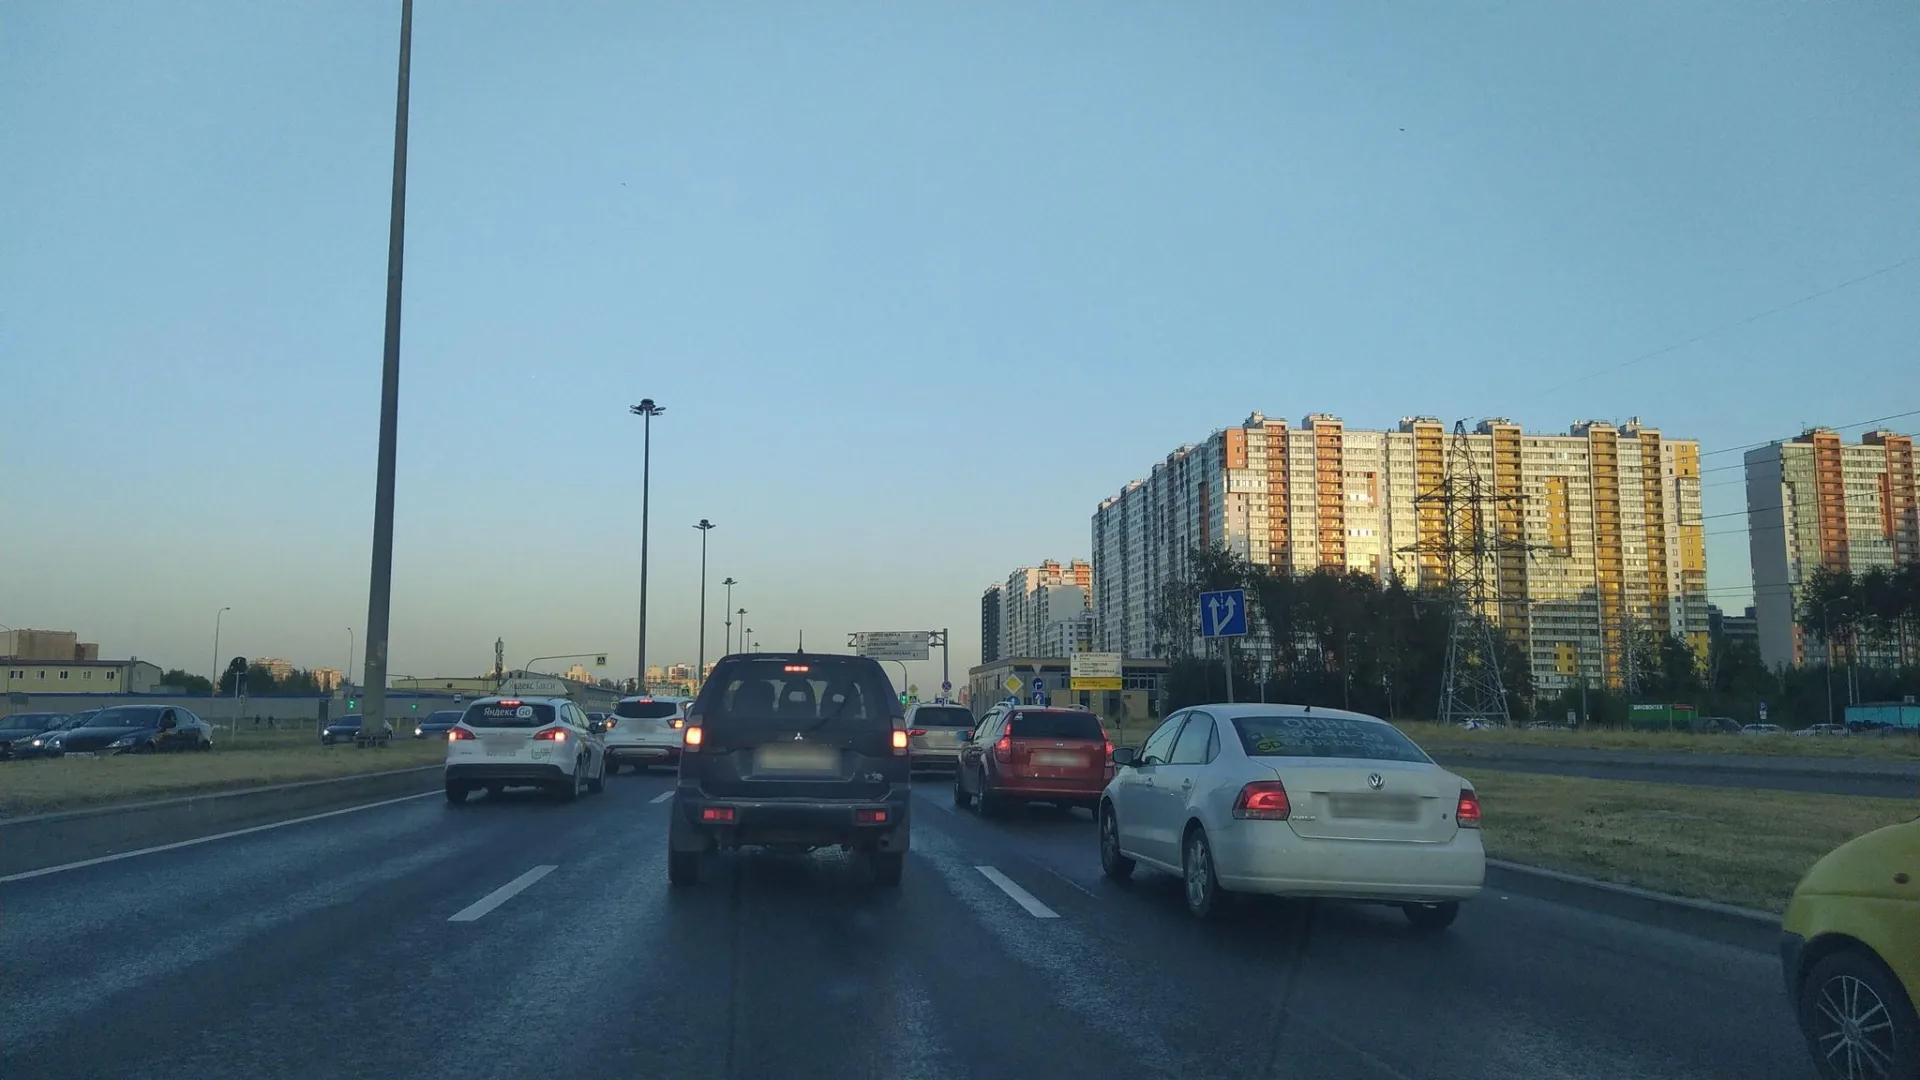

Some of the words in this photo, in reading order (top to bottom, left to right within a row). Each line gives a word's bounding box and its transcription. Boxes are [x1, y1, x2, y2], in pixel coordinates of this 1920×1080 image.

[483, 707, 515, 717] Яндекс
[517, 707, 532, 717] Go
[1257, 740, 1284, 751] GD
